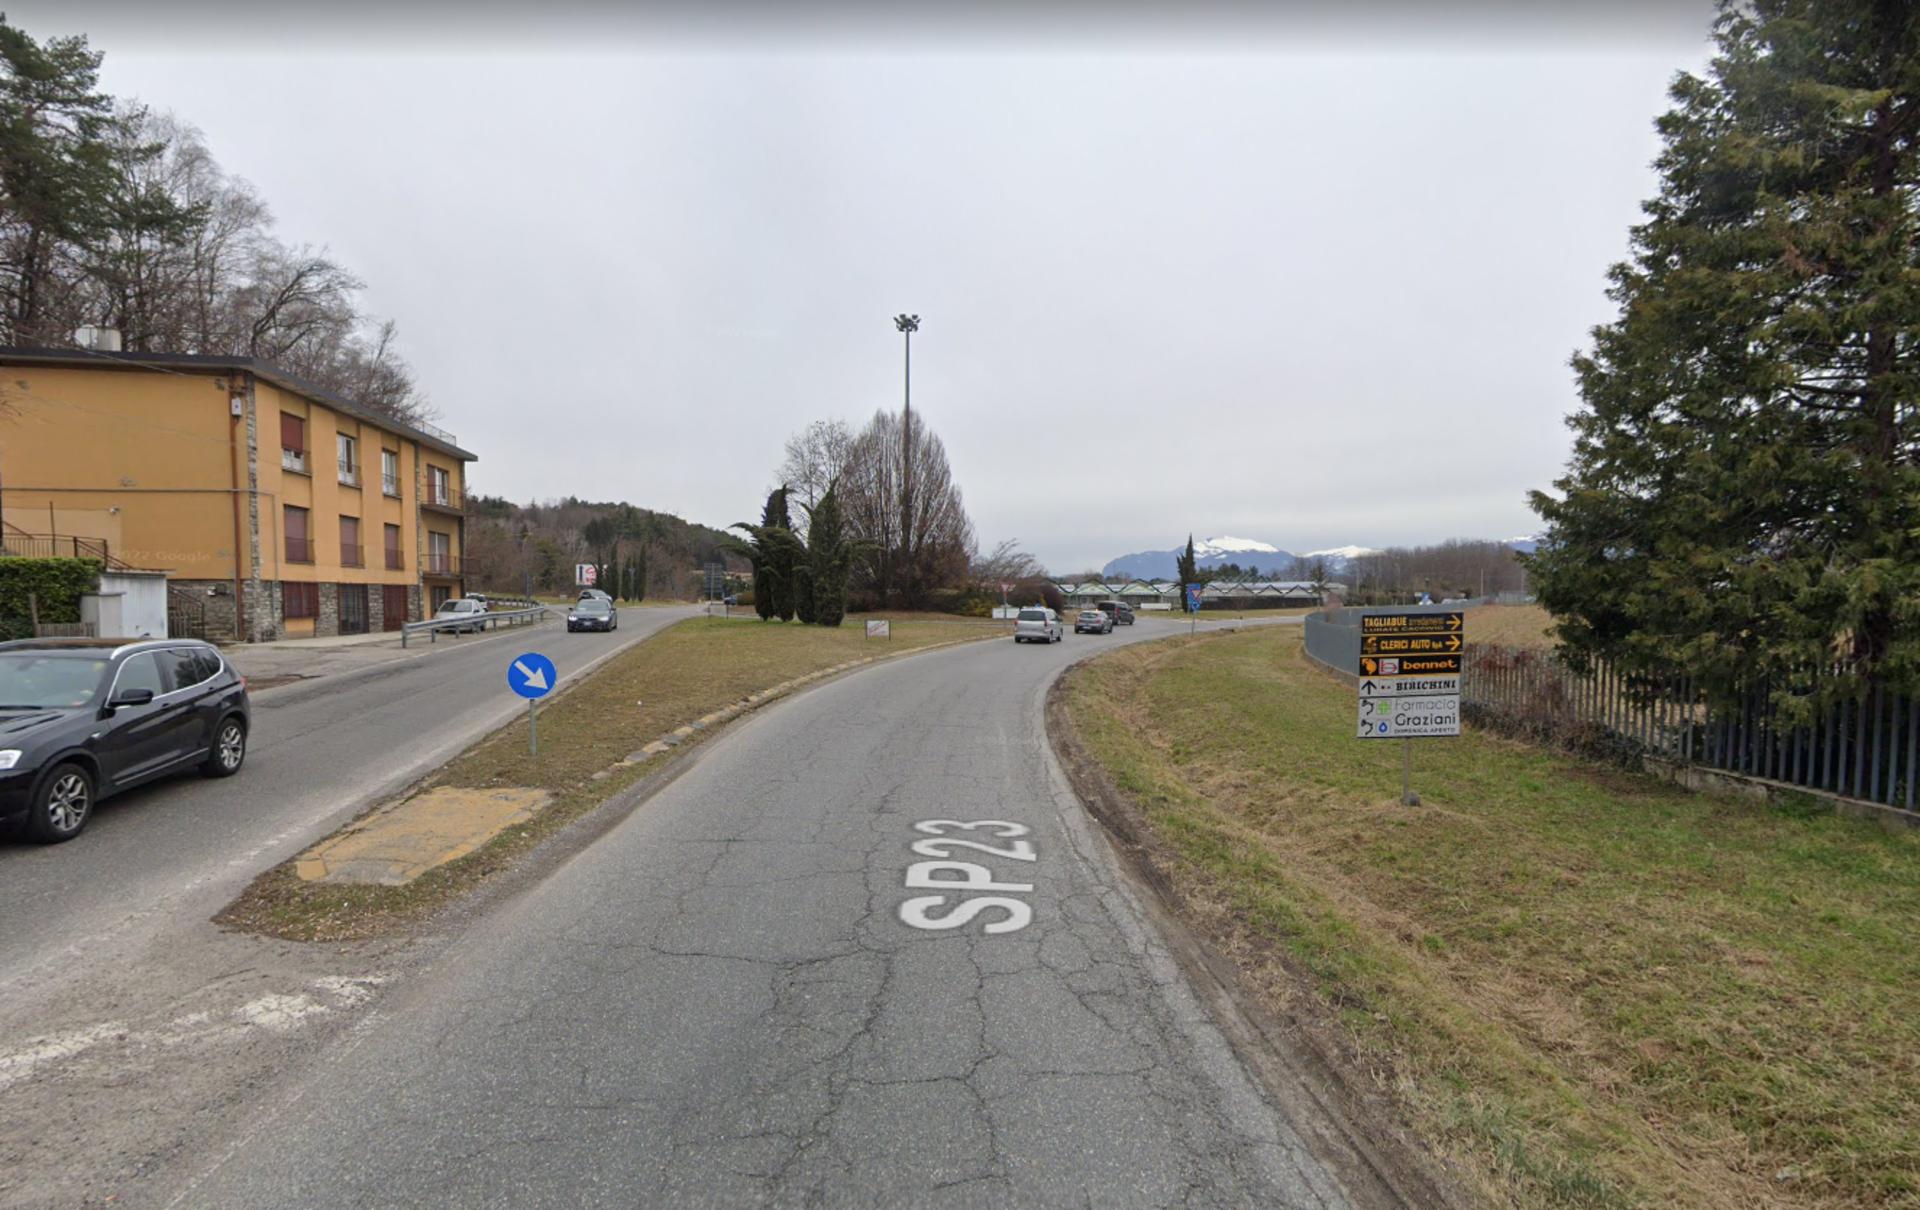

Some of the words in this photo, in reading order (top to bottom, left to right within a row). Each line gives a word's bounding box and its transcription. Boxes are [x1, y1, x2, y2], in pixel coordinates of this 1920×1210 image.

[1364, 617, 1407, 627] TAGLIABUE
[1380, 641, 1408, 650] CLERICI
[1410, 640, 1430, 649] AUTO
[1403, 659, 1457, 670] bennet
[1395, 699, 1456, 711] Farmacia
[1395, 713, 1456, 726] Graziani
[900, 819, 1037, 934] SP23
